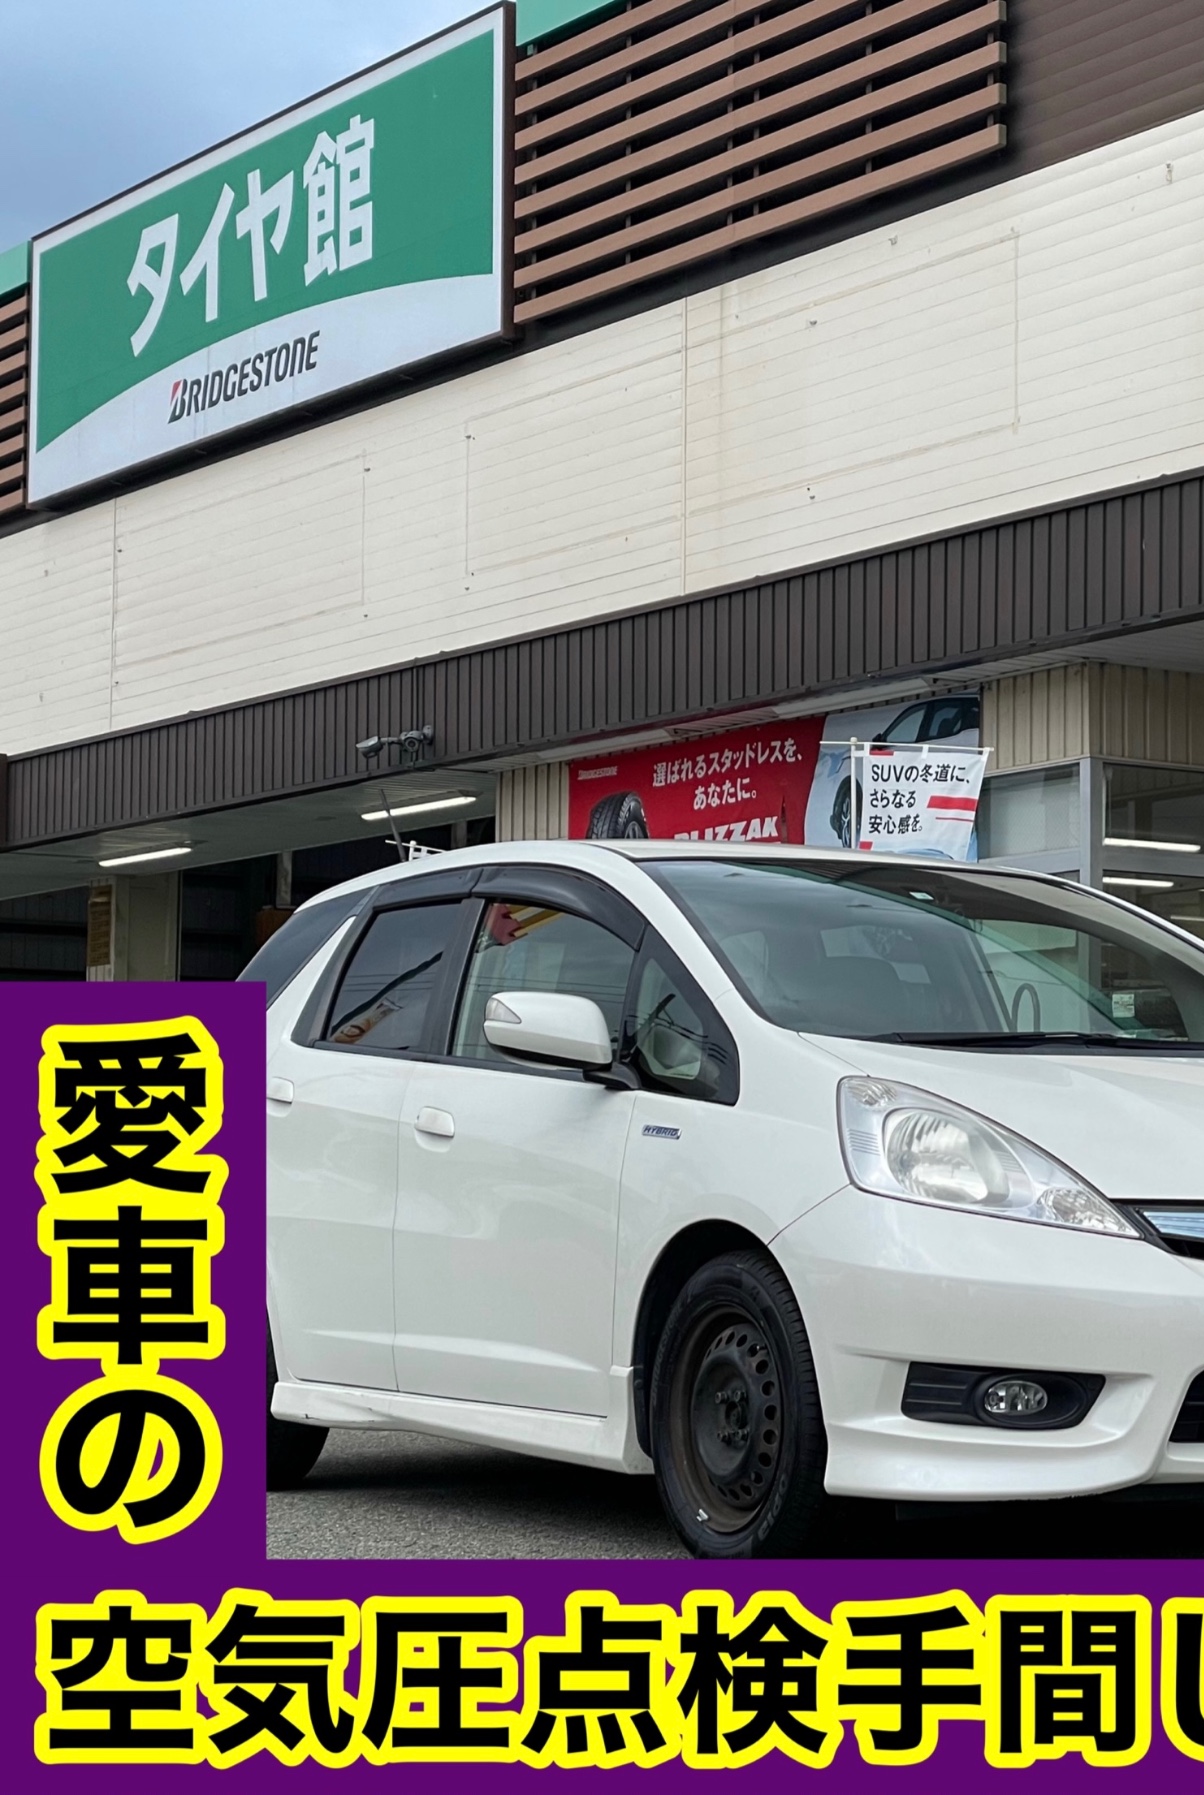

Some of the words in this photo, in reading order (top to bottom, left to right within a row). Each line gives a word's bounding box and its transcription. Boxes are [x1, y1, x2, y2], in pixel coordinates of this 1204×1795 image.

[127, 114, 374, 357] タイヤ館
[167, 331, 319, 424] BRIDGESTONE
[652, 737, 803, 788] 選ばれるスタッドレスを、
[871, 763, 971, 785] SUVの冬道に、
[693, 777, 757, 811] あなたに。
[869, 788, 917, 810] さらなる
[868, 813, 924, 835] 安心感を。
[643, 1125, 678, 1138] HYBRID
